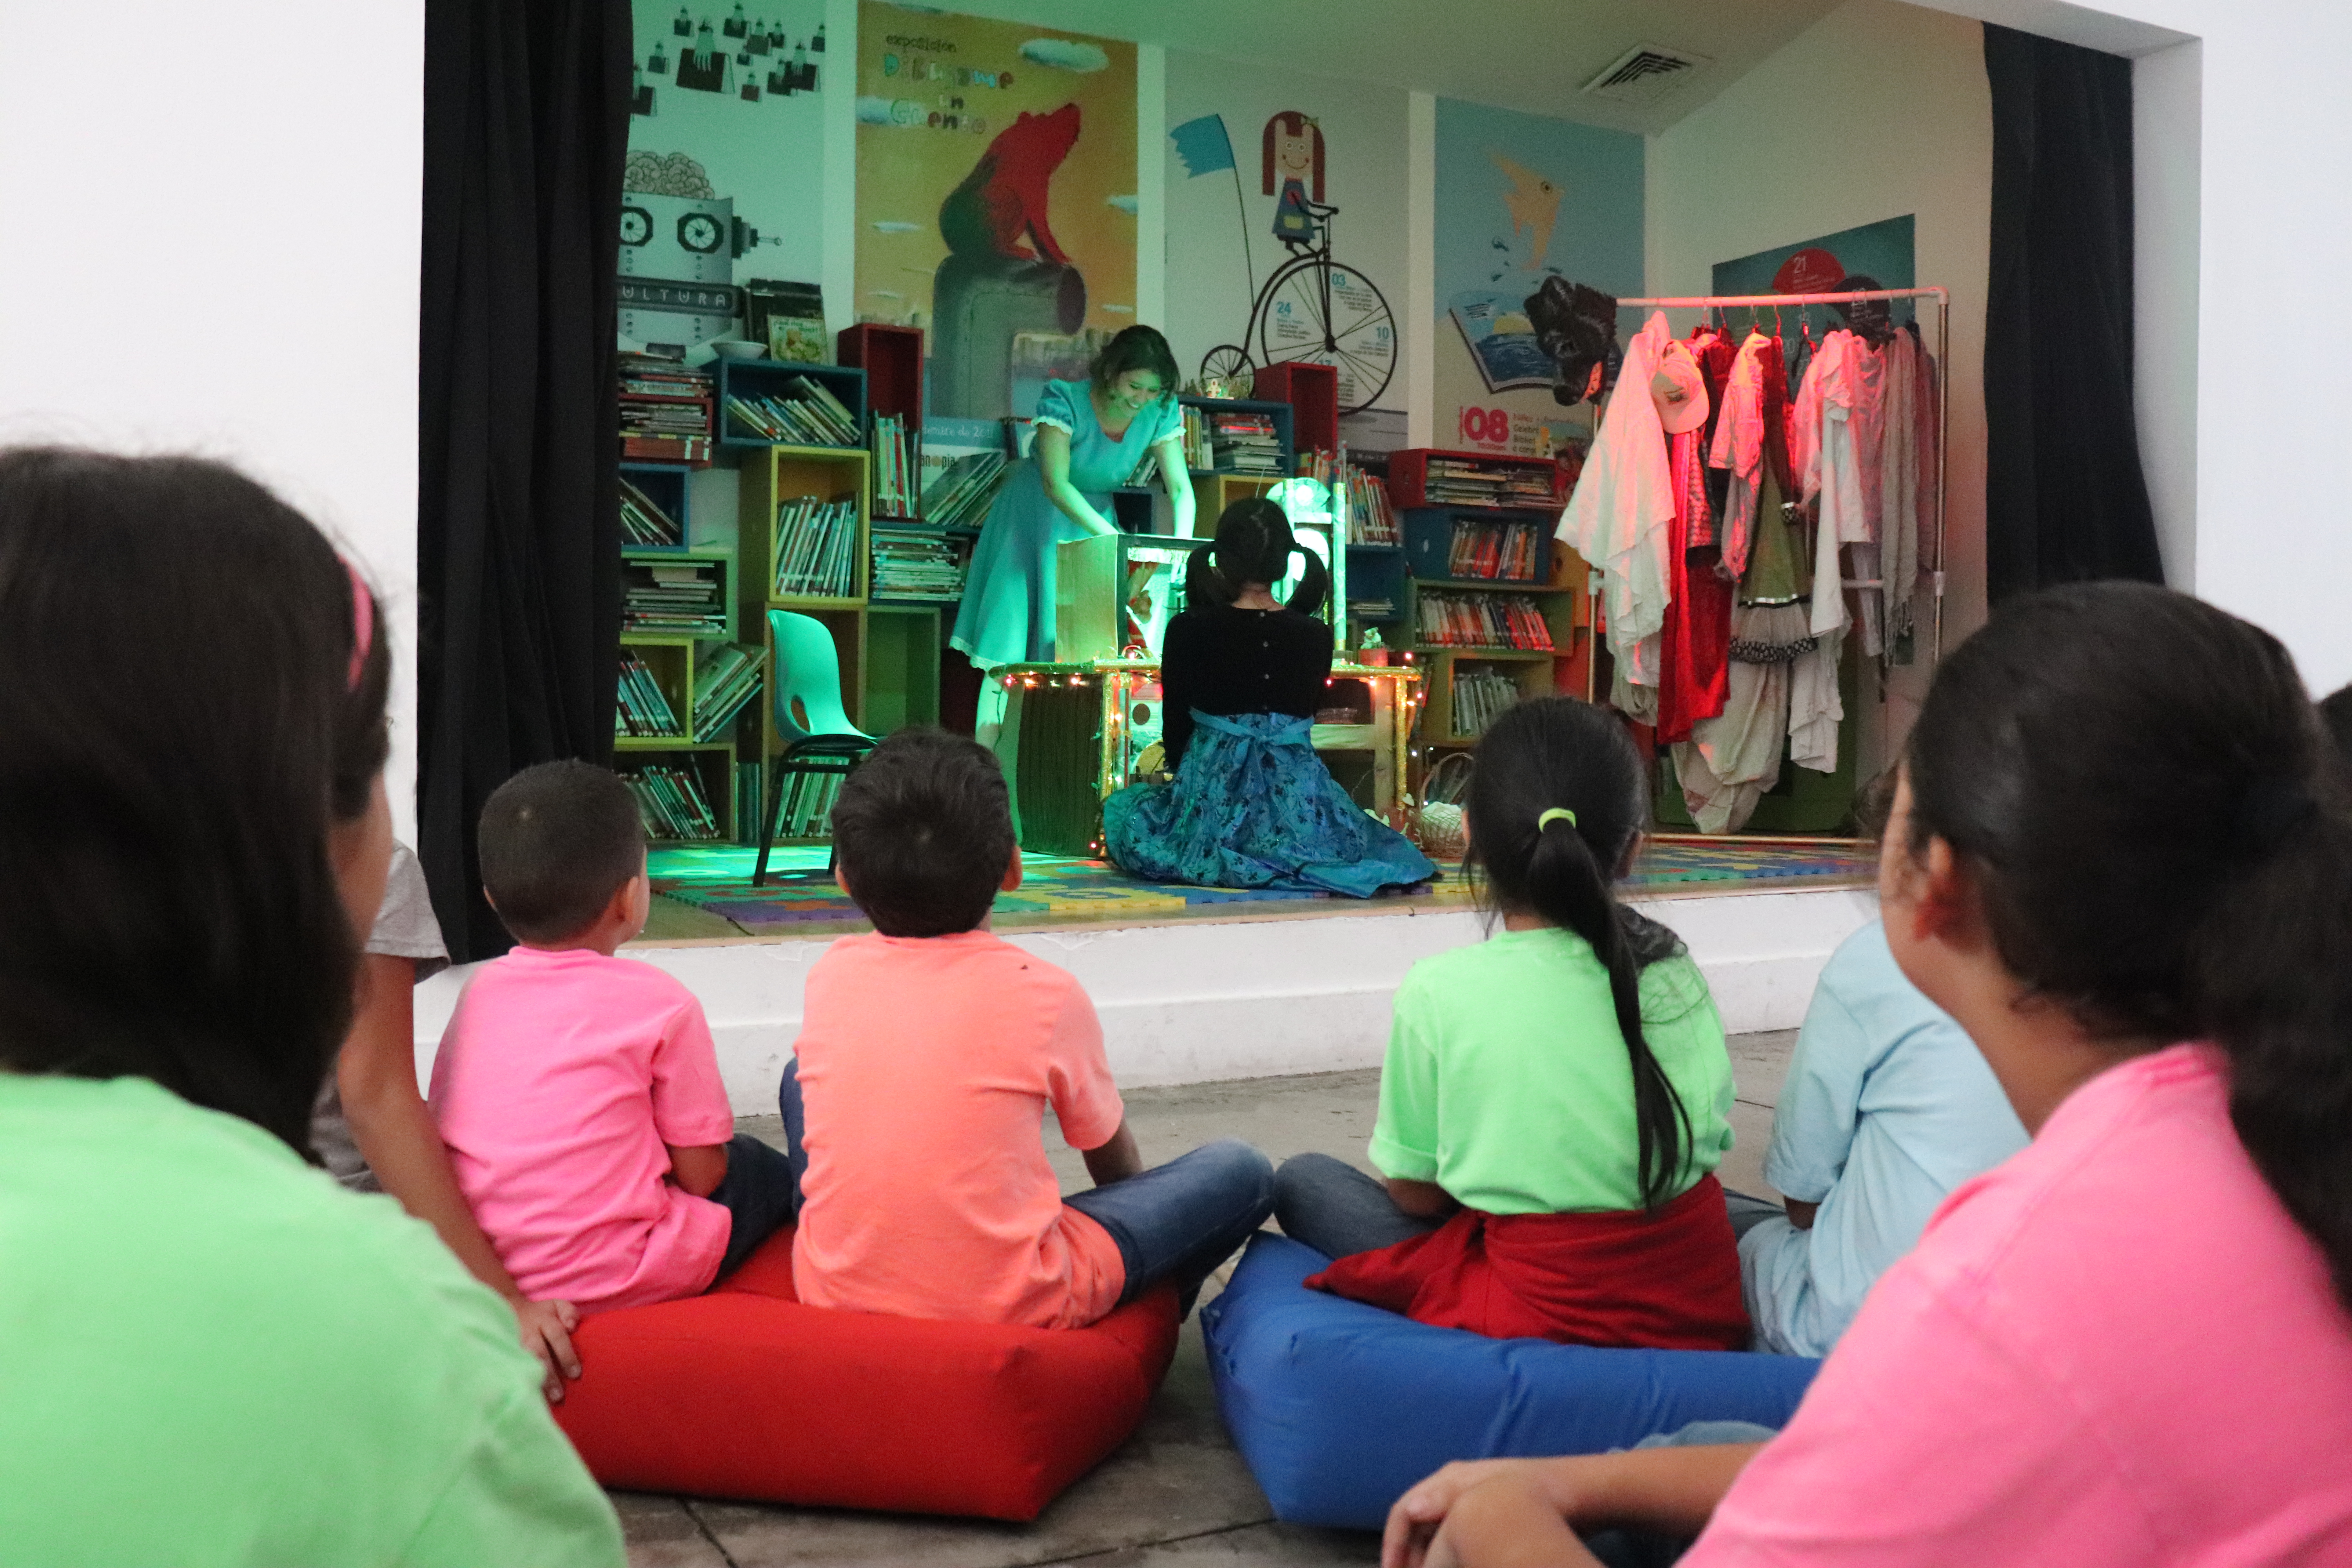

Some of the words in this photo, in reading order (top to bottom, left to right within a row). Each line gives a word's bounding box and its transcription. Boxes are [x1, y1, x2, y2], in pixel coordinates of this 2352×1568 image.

[1793, 256, 1806, 274] 21
[1332, 273, 1346, 286] 03
[1277, 301, 1291, 314] 24
[1376, 326, 1389, 339] 10
[1465, 407, 1509, 443] 08
